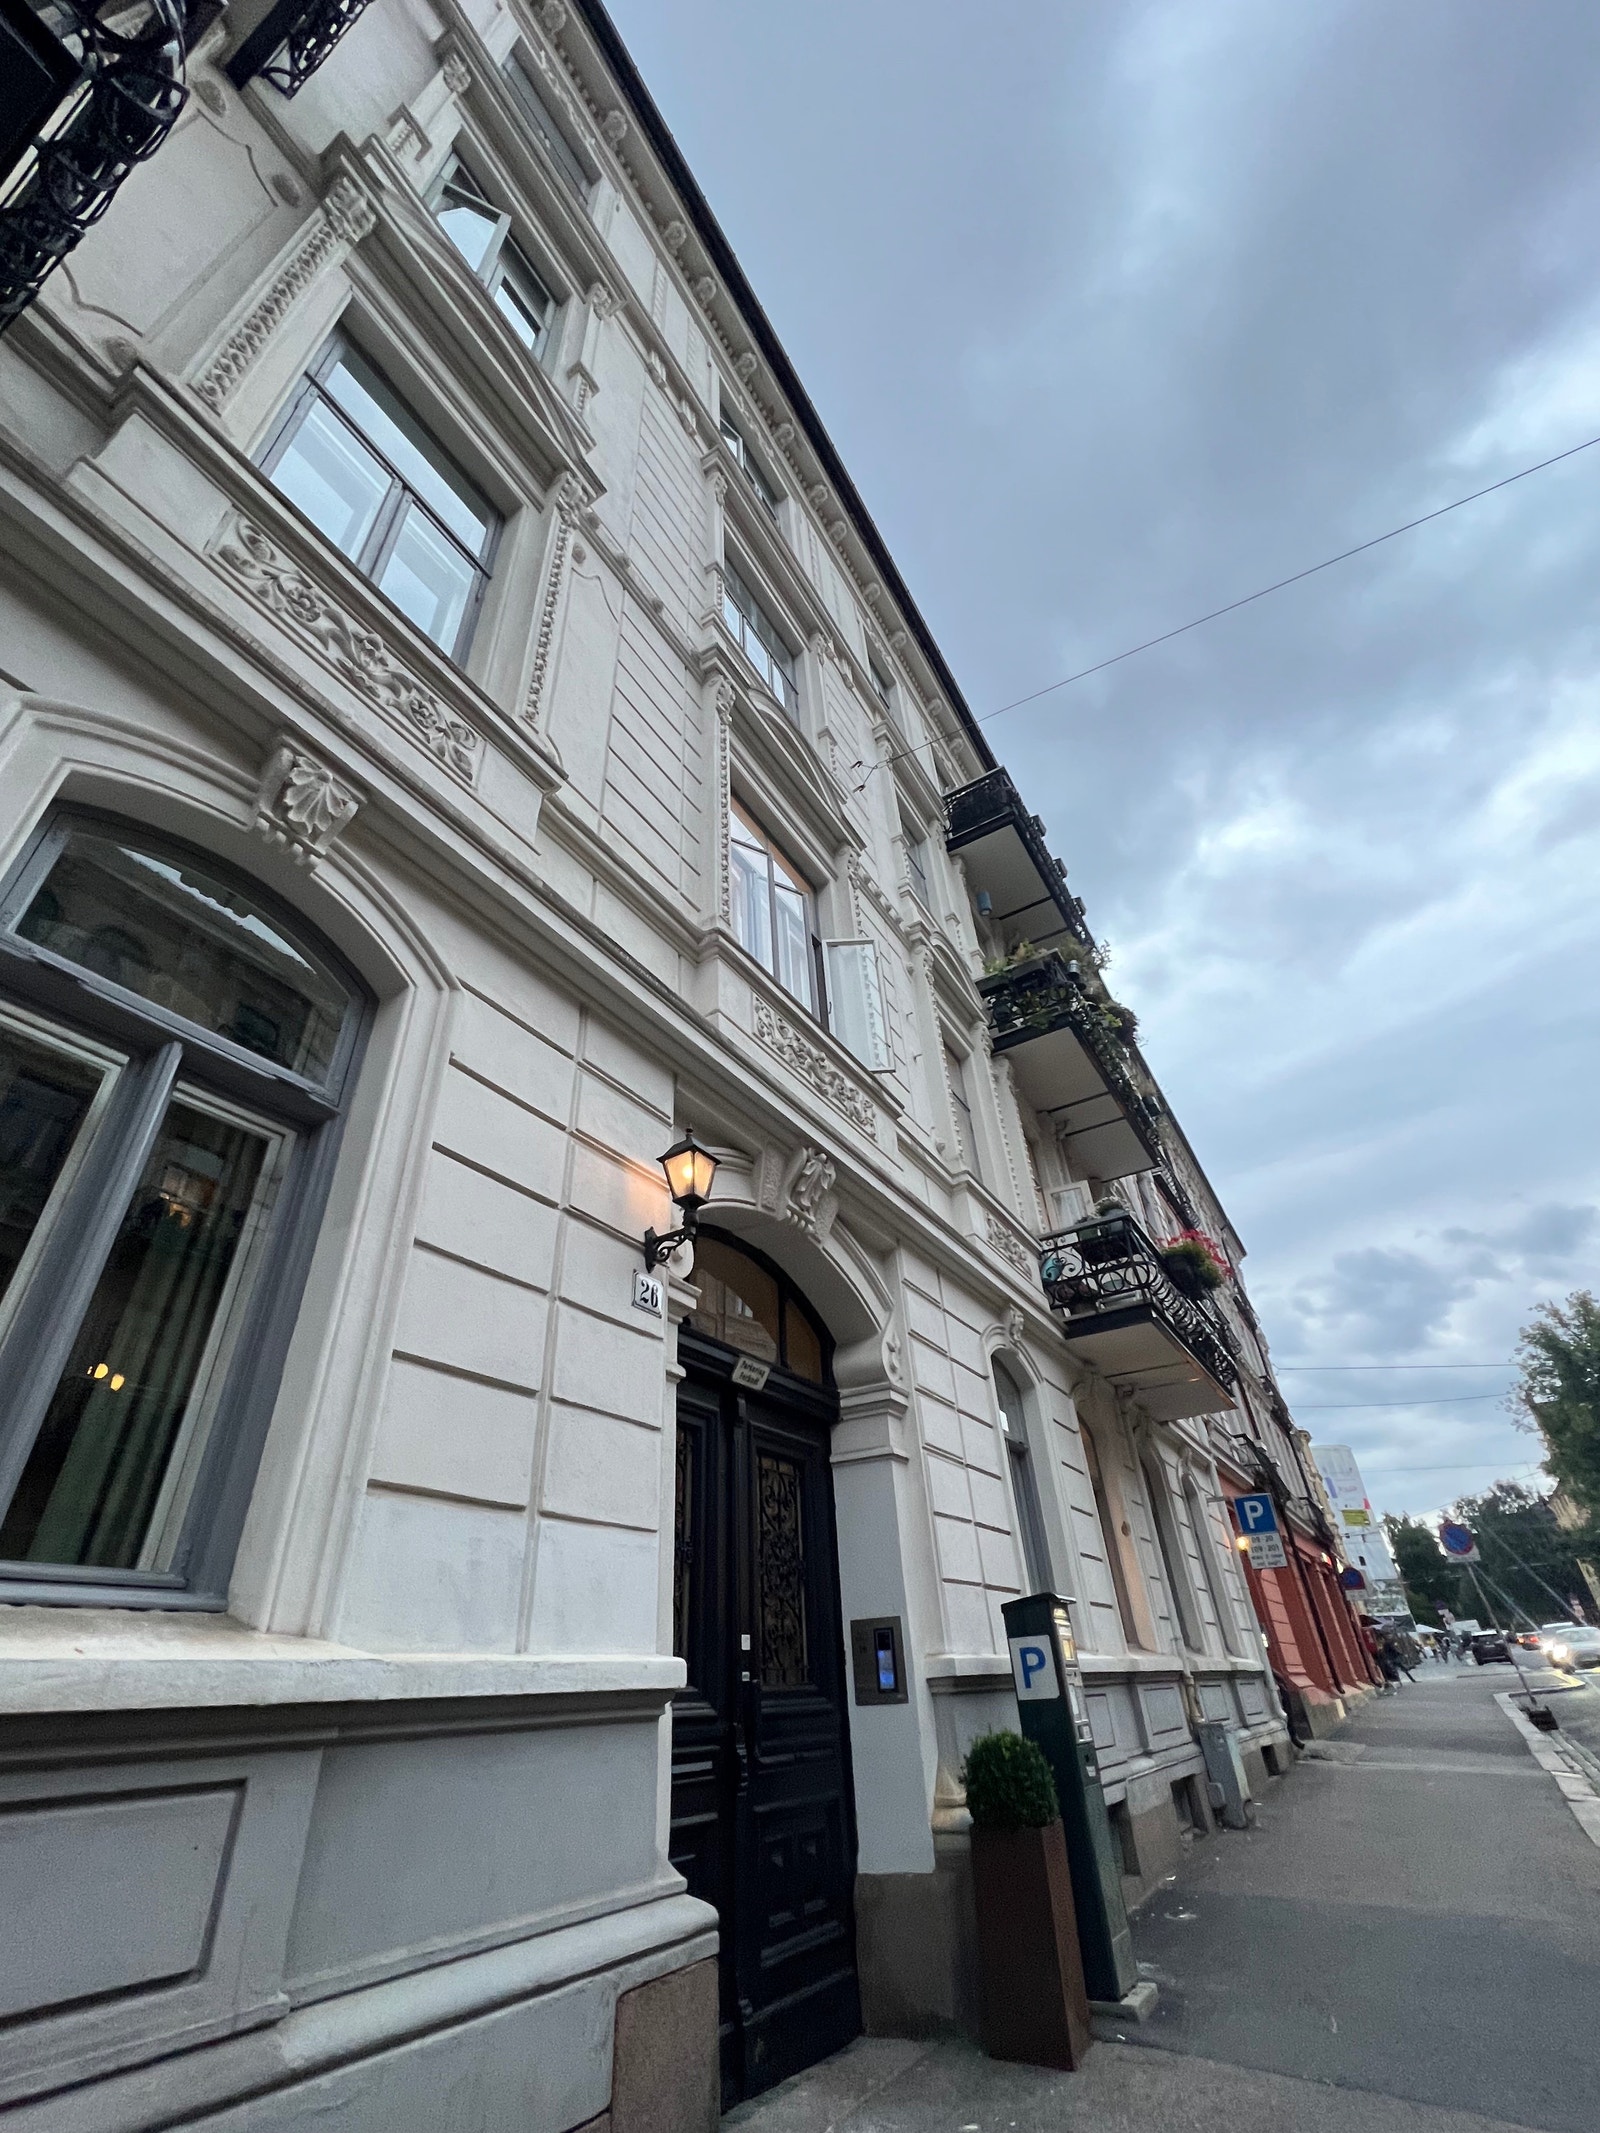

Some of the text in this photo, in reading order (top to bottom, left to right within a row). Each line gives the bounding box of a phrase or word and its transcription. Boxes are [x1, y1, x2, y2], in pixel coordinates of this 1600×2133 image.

[640, 1279, 659, 1308] 26
[1243, 1500, 1264, 1529] P
[1019, 1646, 1046, 1689] P
